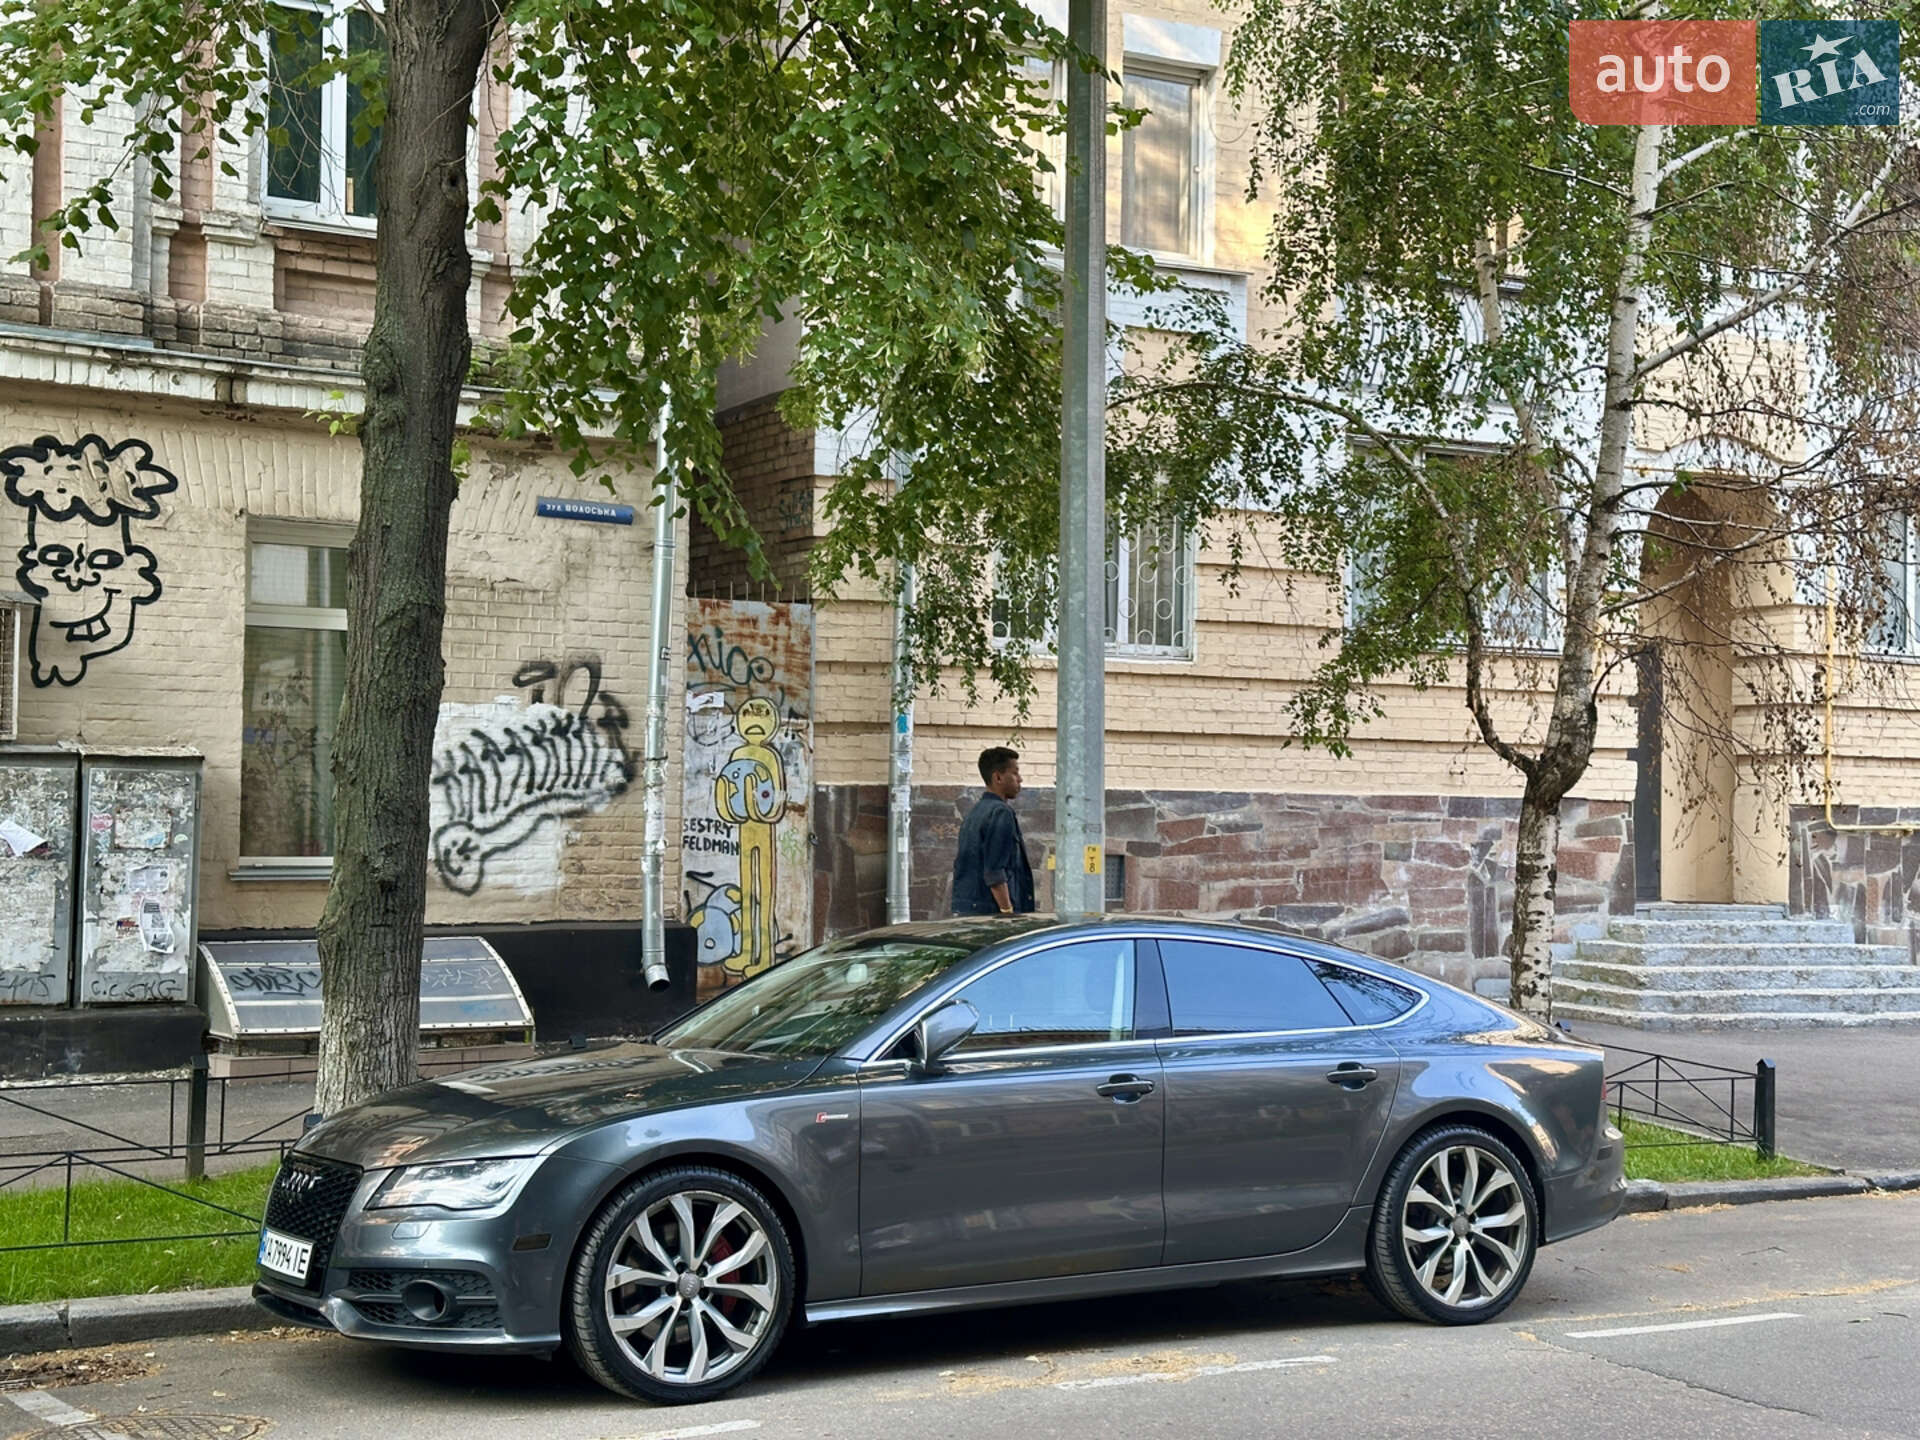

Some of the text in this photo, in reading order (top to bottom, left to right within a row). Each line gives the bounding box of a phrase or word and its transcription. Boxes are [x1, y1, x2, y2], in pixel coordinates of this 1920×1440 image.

[683, 817, 734, 838] SESTRY
[682, 835, 740, 856] FELDMAN
[264, 1237, 309, 1275] A7994IE
